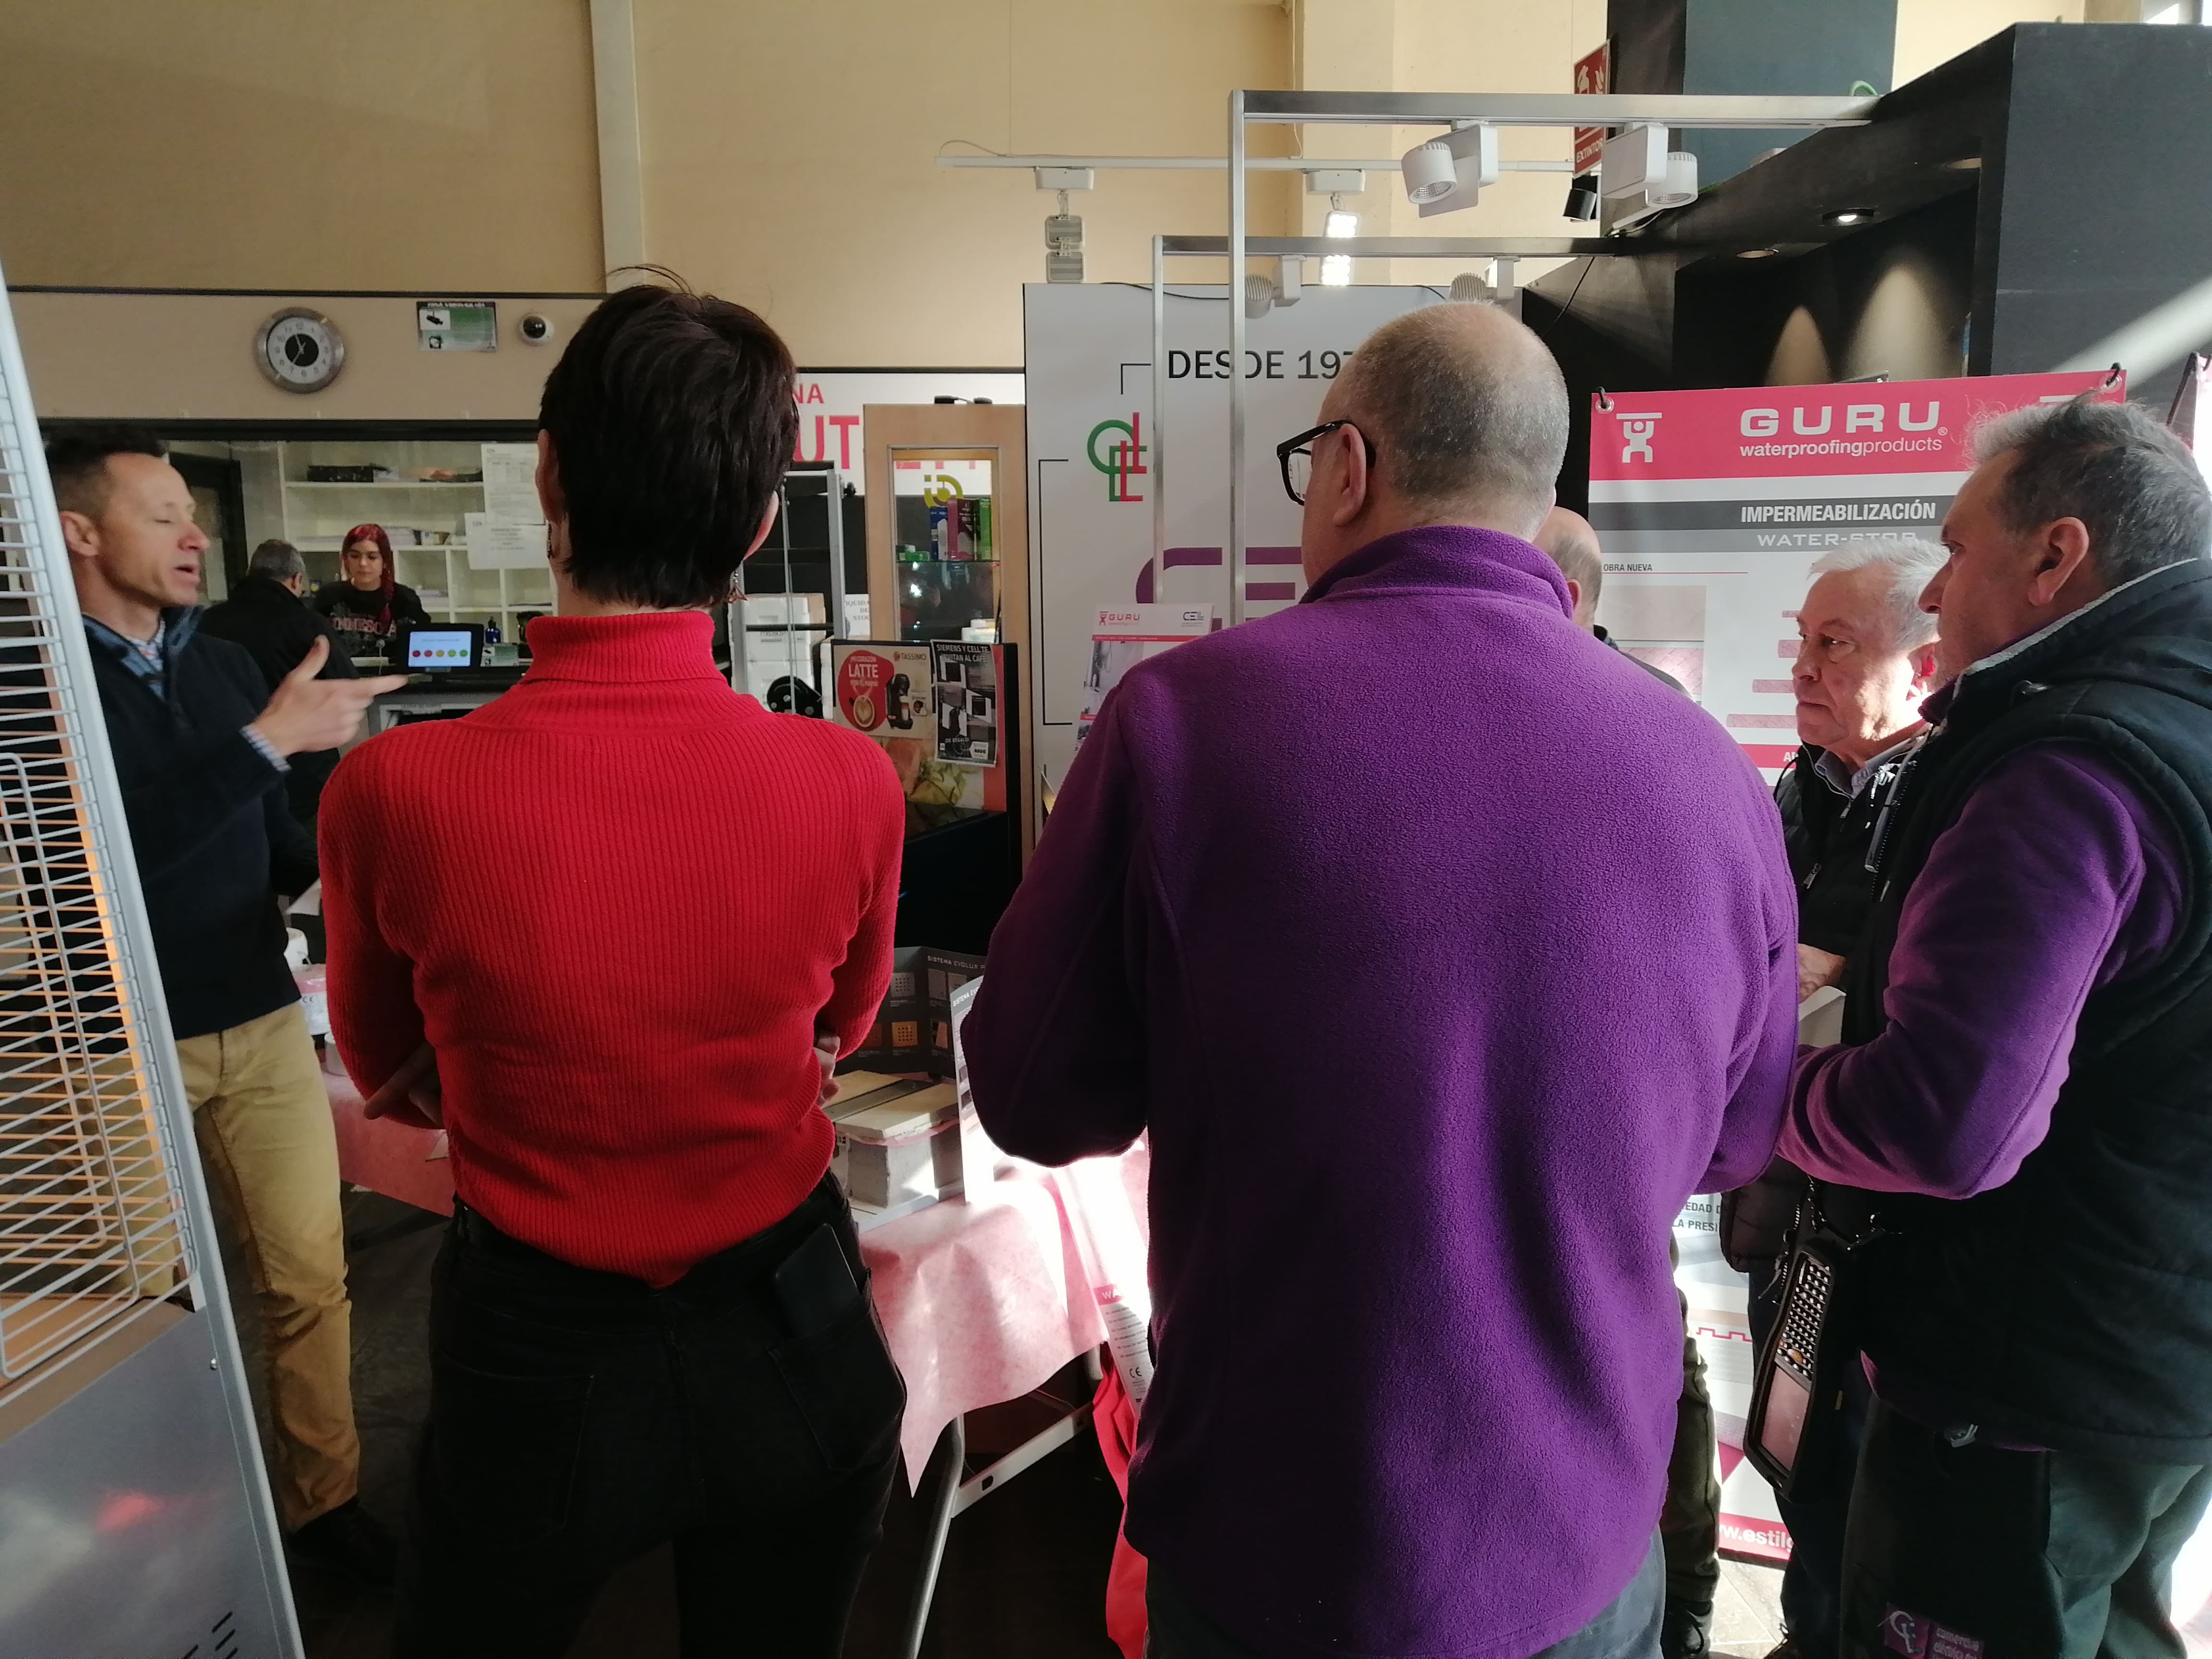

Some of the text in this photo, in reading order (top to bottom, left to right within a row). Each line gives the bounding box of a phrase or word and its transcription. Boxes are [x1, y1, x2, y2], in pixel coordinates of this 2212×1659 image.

[1168, 350, 1353, 379] DESDE 19
[1740, 437, 1942, 458] waterproofingproducts
[1741, 499, 1936, 522] IMPERMEABILIZACIÓN
[1603, 564, 1653, 572] OBRA NUEVA
[901, 652, 927, 661] TASSIMO
[848, 663, 878, 678] LATTE
[927, 955, 952, 965] SISTEMA
[1688, 1220, 1718, 1232] PRESI
